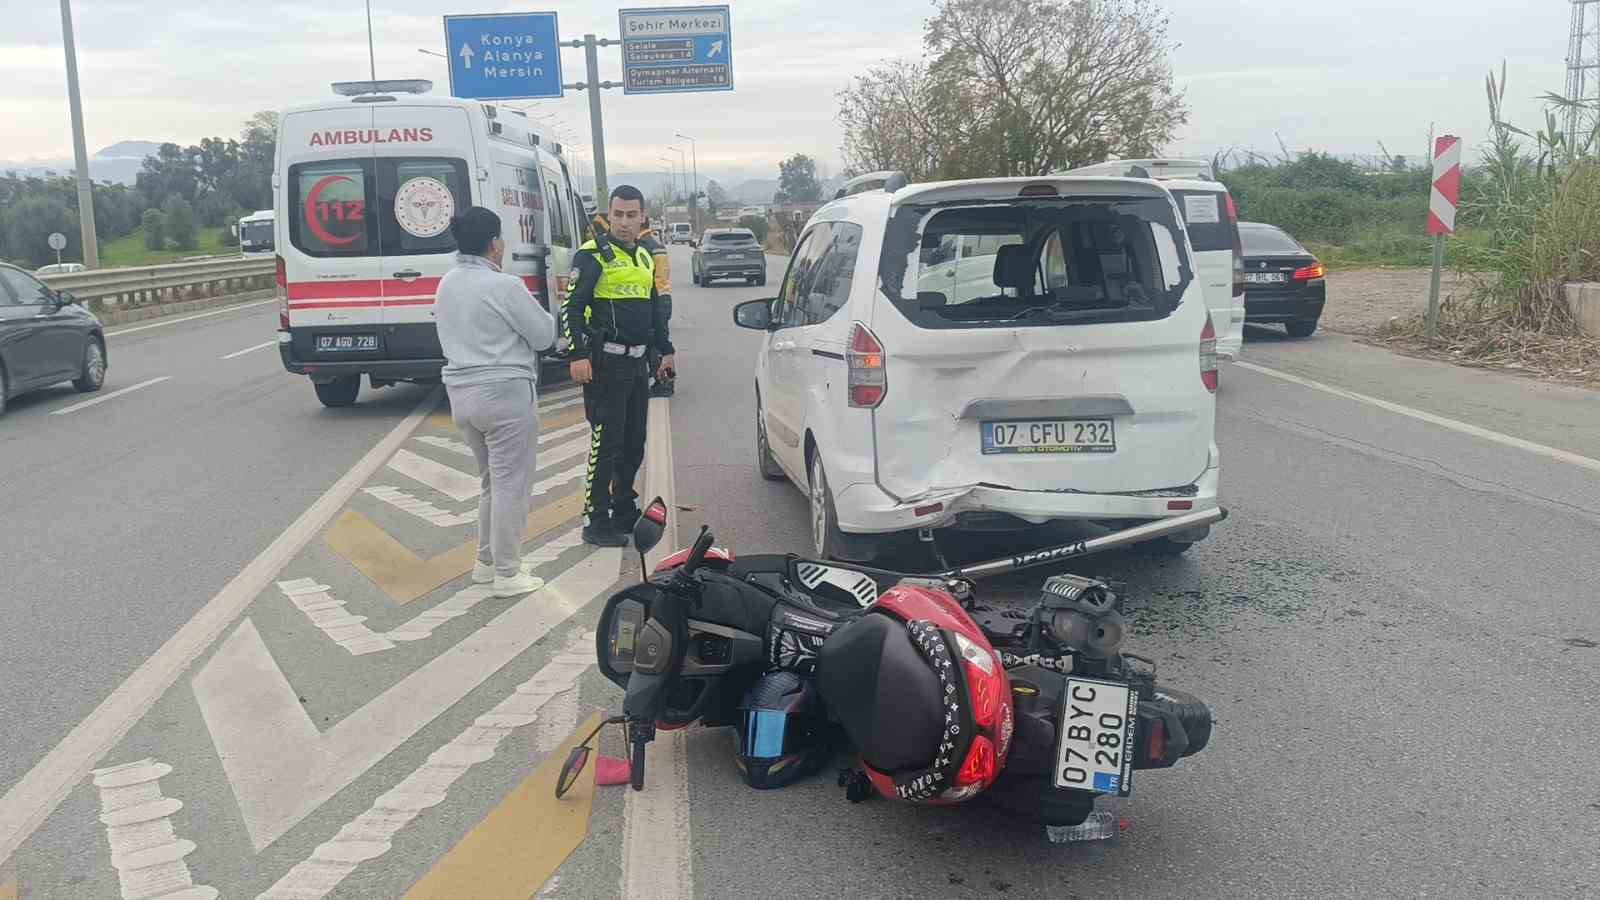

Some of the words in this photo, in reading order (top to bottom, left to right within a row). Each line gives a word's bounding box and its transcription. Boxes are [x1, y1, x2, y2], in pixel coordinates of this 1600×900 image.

[669, 19, 721, 30] Merkezi
[480, 33, 533, 47] Konya
[484, 49, 543, 63] Alanya
[484, 65, 543, 78] Mersin
[309, 127, 433, 146] AMBULANS
[319, 199, 365, 224] 112
[519, 214, 537, 244] 112
[995, 425, 1017, 445] 07
[1030, 423, 1066, 444] CFU
[1074, 422, 1110, 444] 232
[1069, 686, 1097, 741] BYC
[1095, 713, 1122, 768] 280
[1125, 717, 1137, 762] ERDEM
[1063, 748, 1089, 783] 07
[1109, 776, 1119, 791] TR
